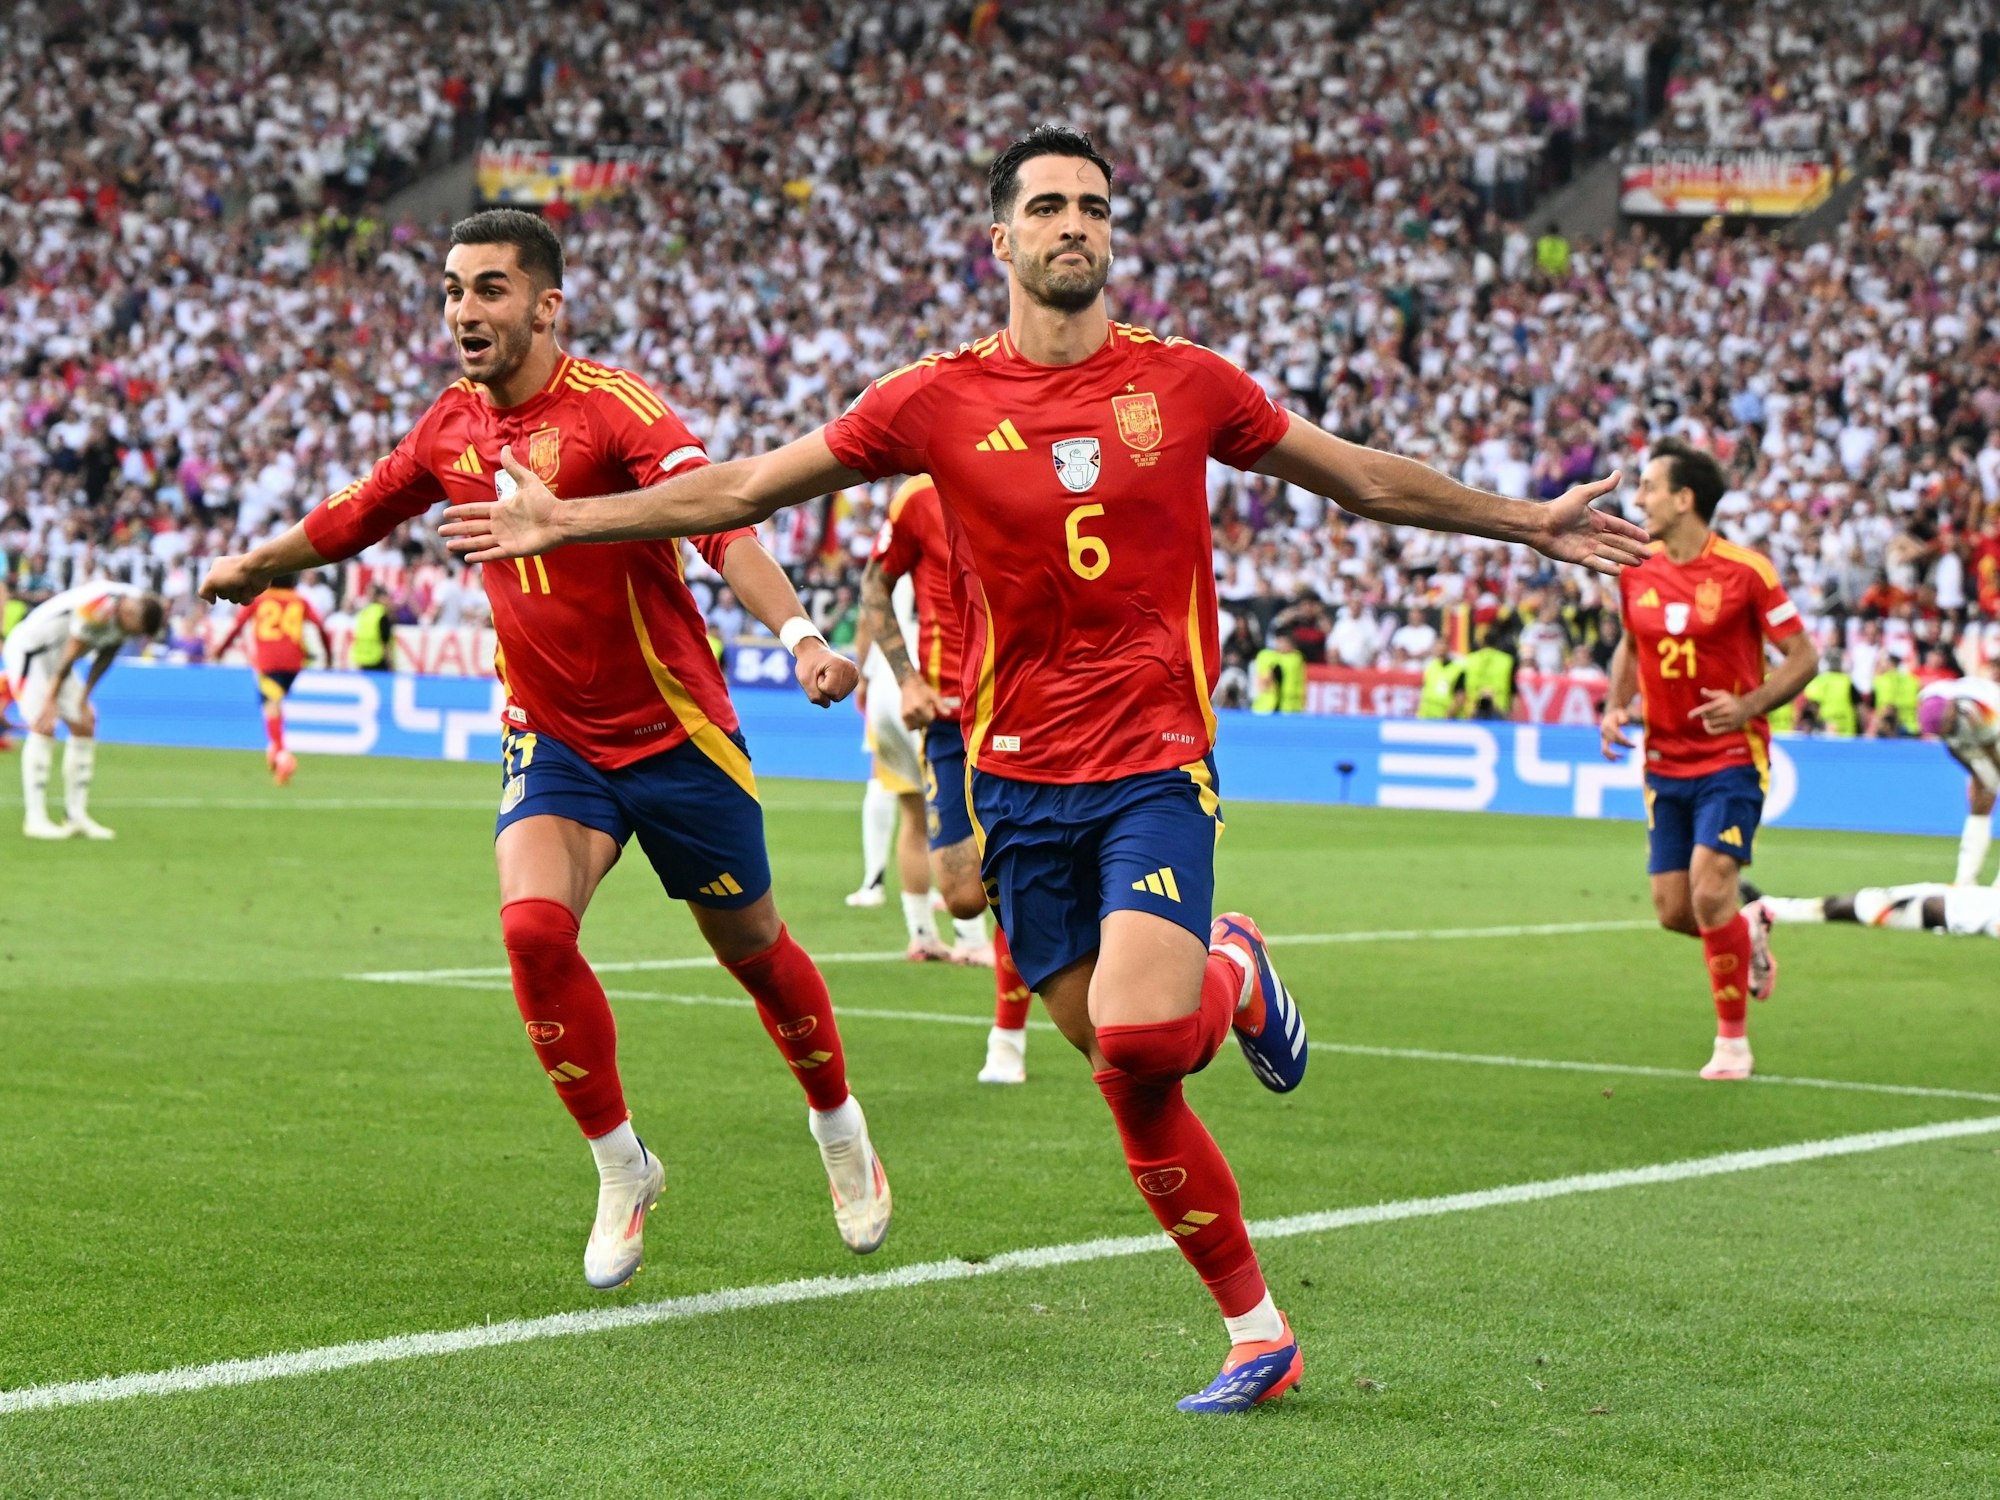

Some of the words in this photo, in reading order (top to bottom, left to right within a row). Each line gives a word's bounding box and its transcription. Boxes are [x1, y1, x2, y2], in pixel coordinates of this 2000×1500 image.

[1065, 503, 1110, 581] 6
[255, 598, 305, 644] 24
[735, 648, 790, 684] 54
[1657, 637, 1697, 679] 21
[280, 672, 506, 761] BY
